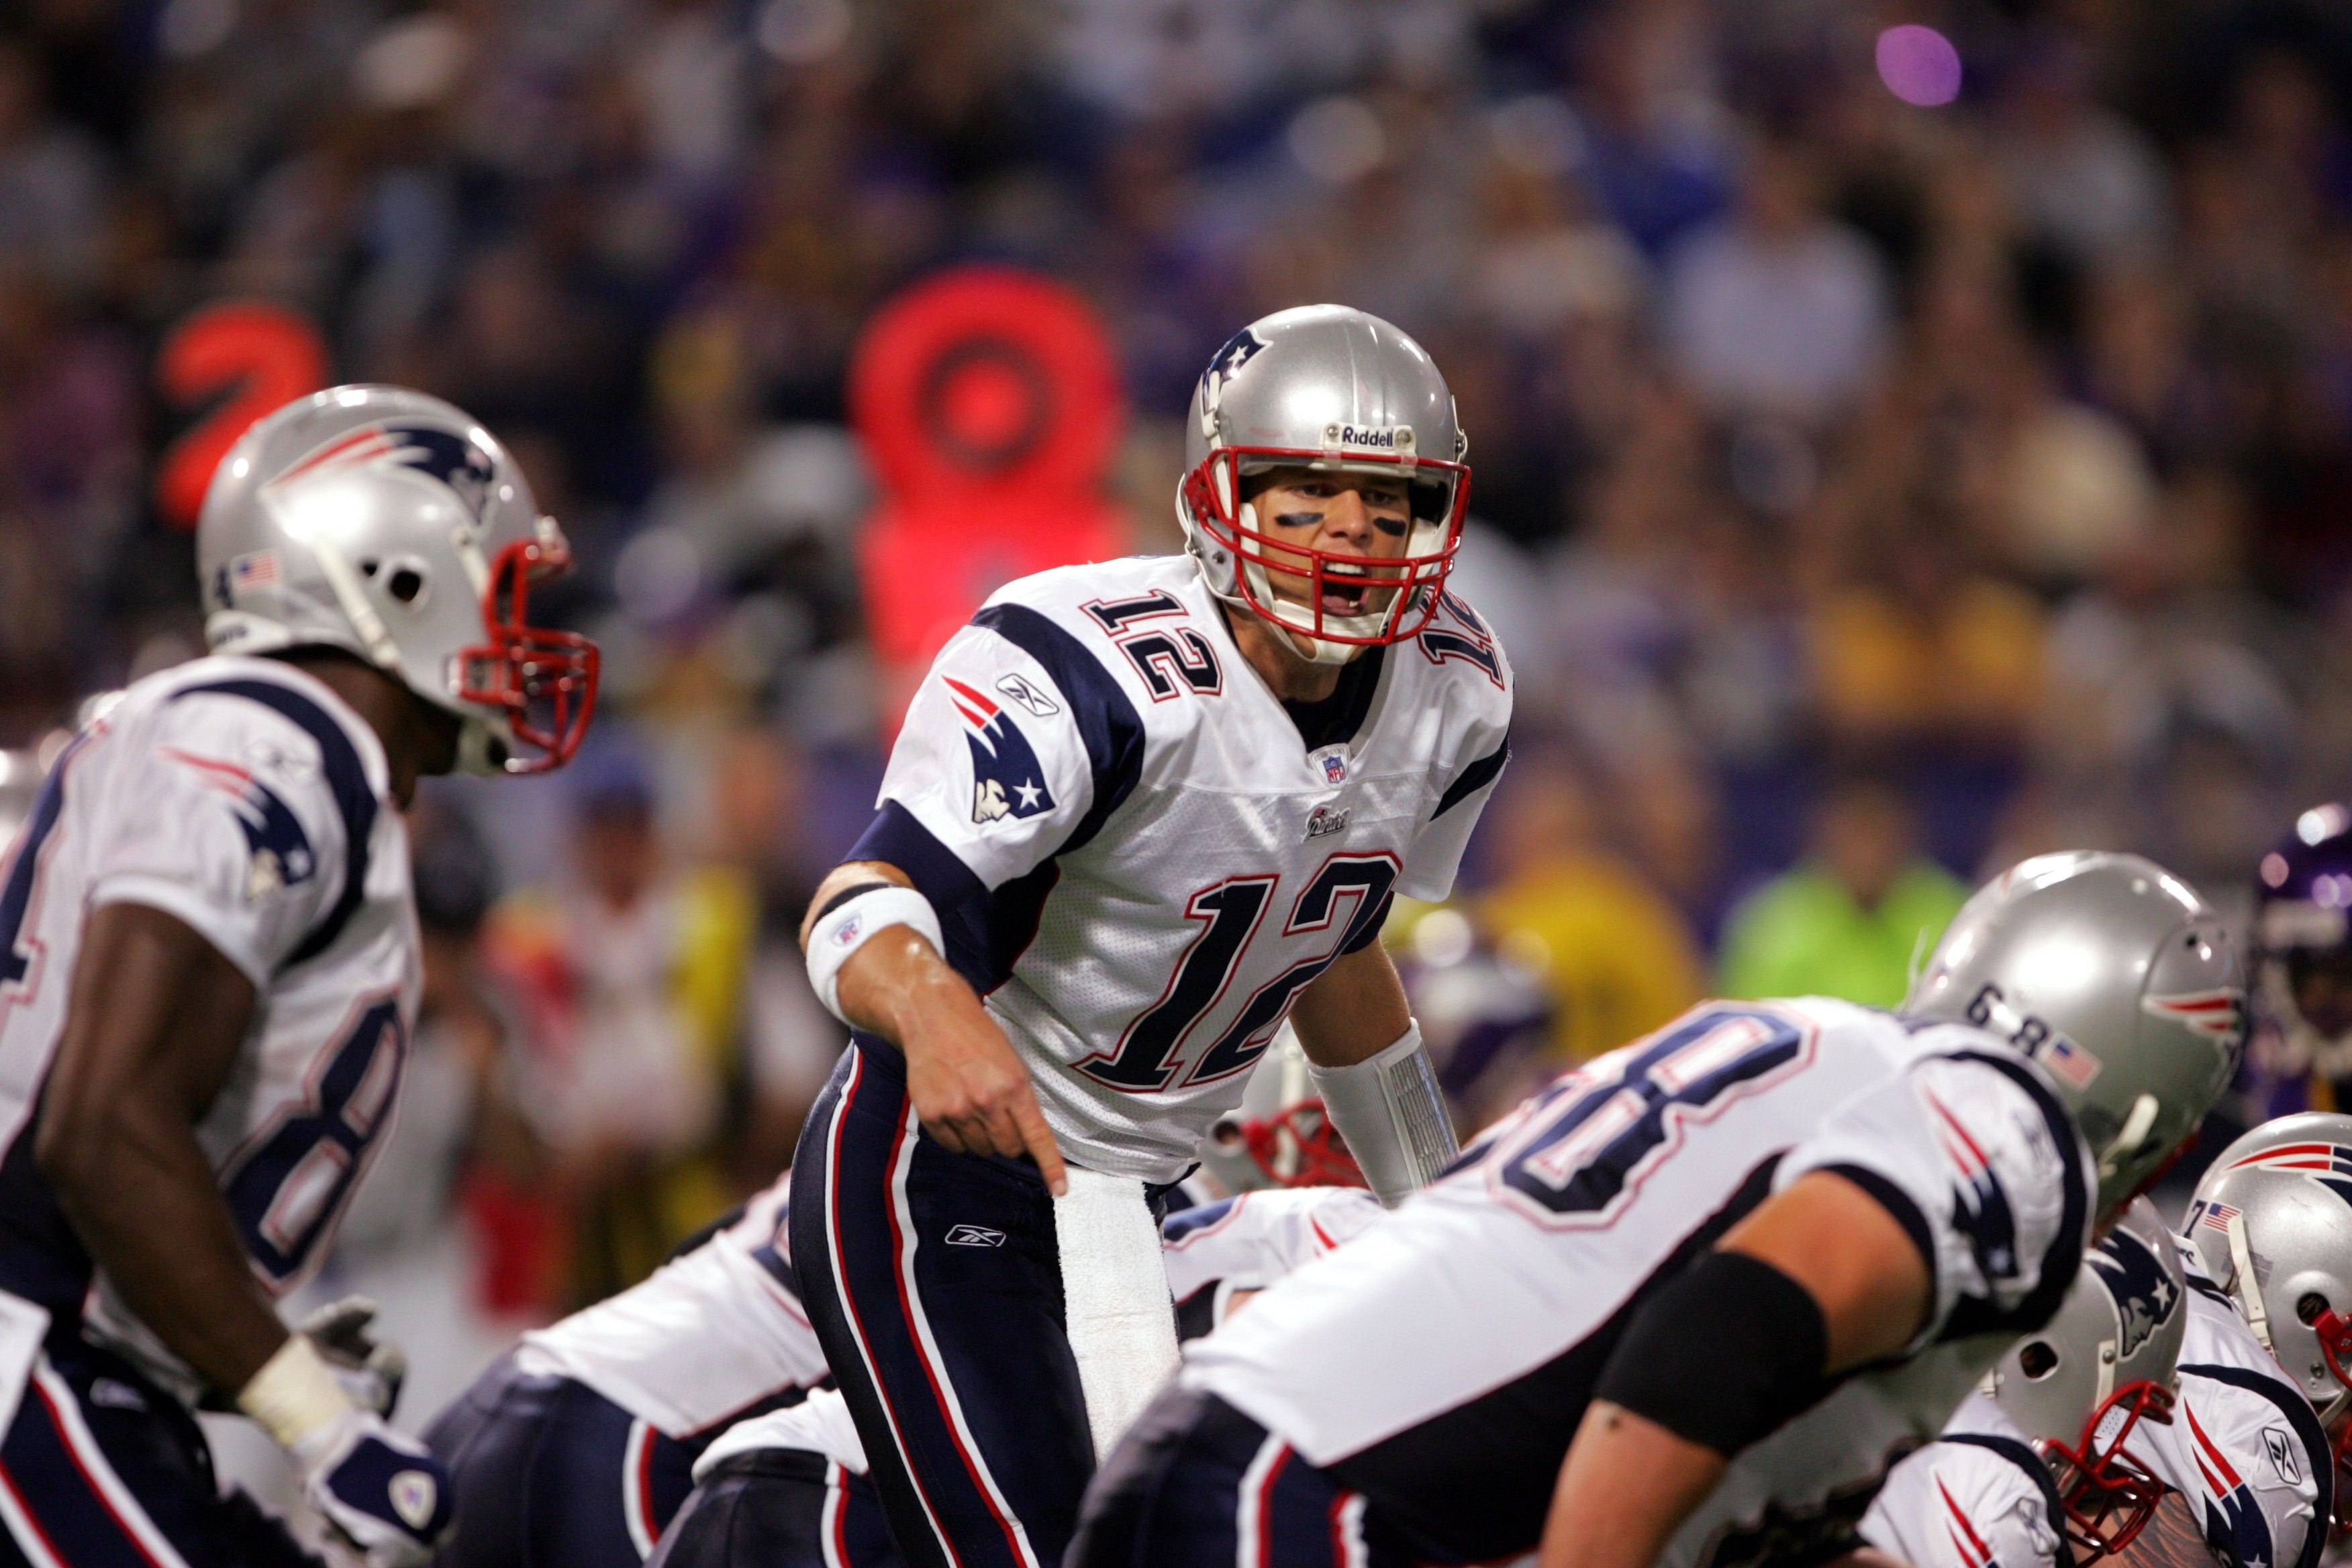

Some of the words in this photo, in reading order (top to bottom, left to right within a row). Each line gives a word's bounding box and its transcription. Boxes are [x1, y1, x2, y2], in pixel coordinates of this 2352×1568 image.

[1342, 426, 1393, 447] Riddell
[1079, 588, 1223, 703] 12
[1328, 768, 1345, 782] NFL
[1068, 850, 1403, 1093] 12
[1967, 983, 2050, 1057] 68
